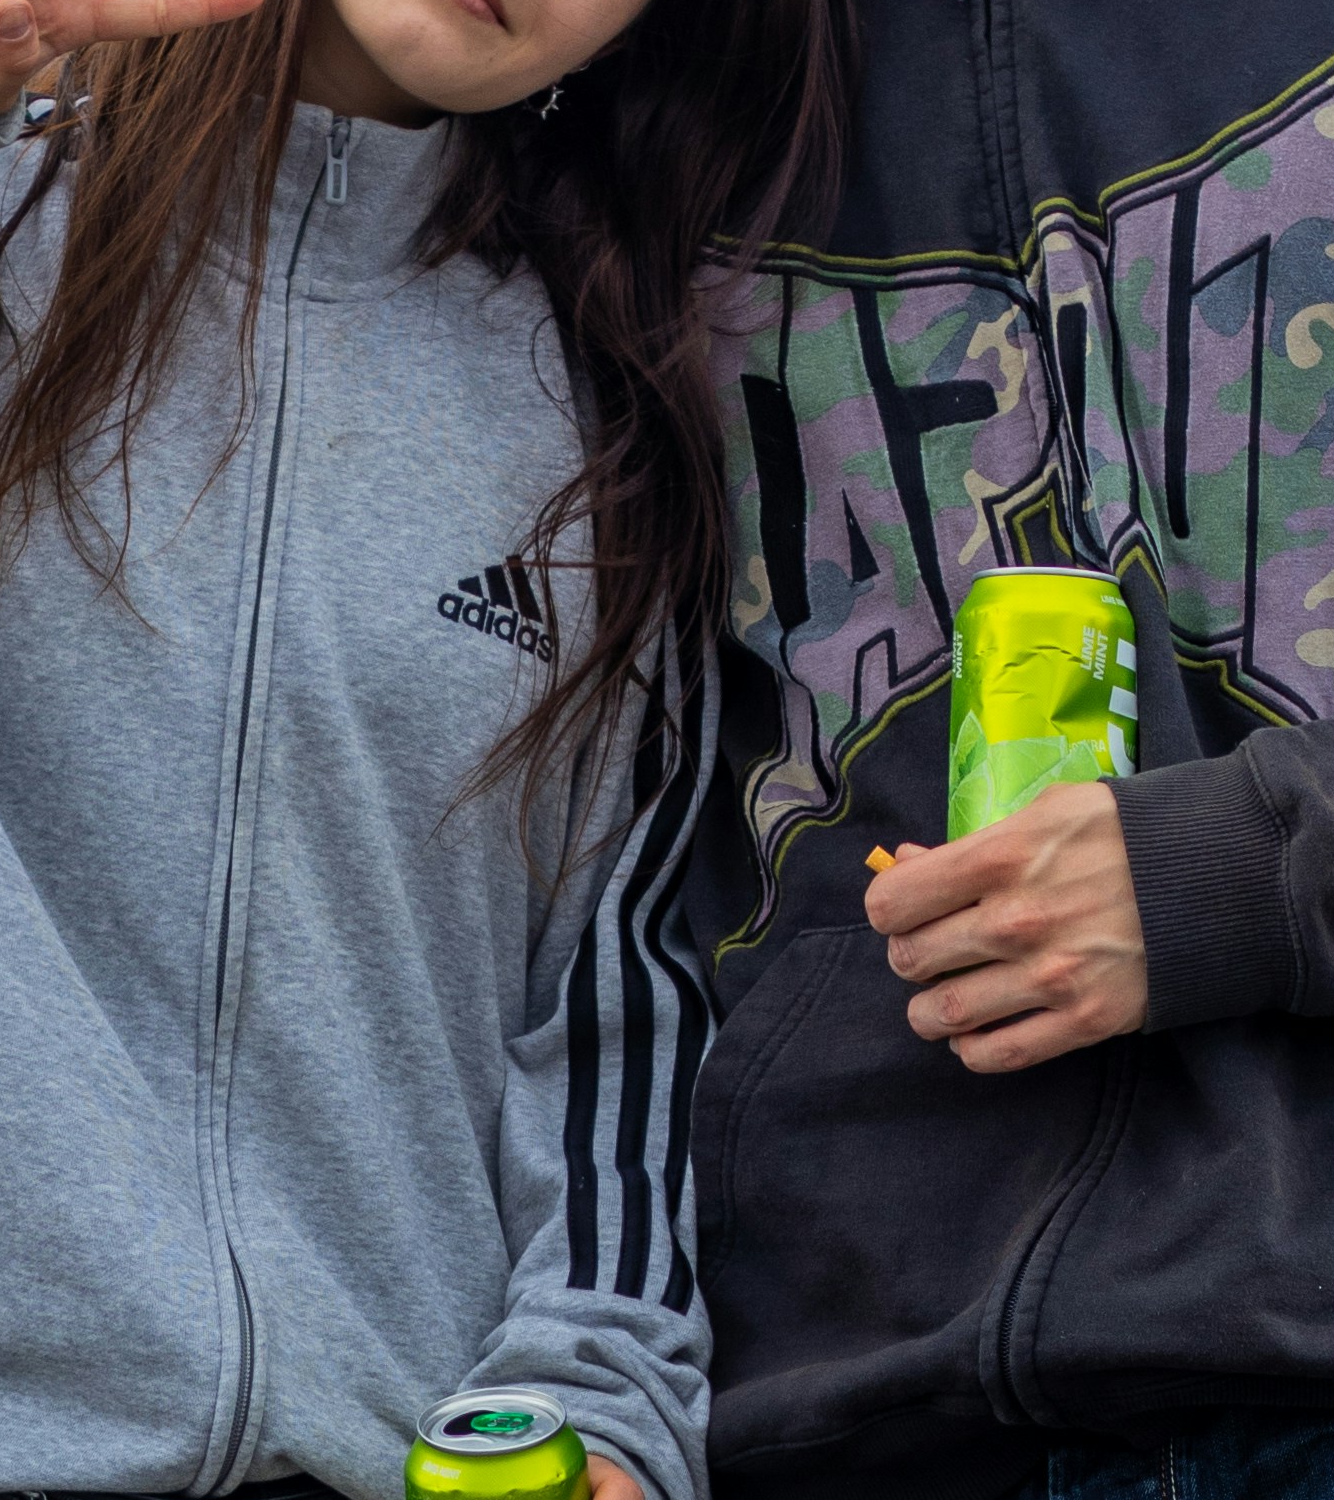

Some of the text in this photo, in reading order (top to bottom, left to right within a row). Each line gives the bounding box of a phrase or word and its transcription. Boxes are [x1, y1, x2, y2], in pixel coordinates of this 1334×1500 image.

[437, 593, 554, 663] adidas
[1080, 625, 1095, 671] LIME
[1092, 629, 1109, 681] MINT
